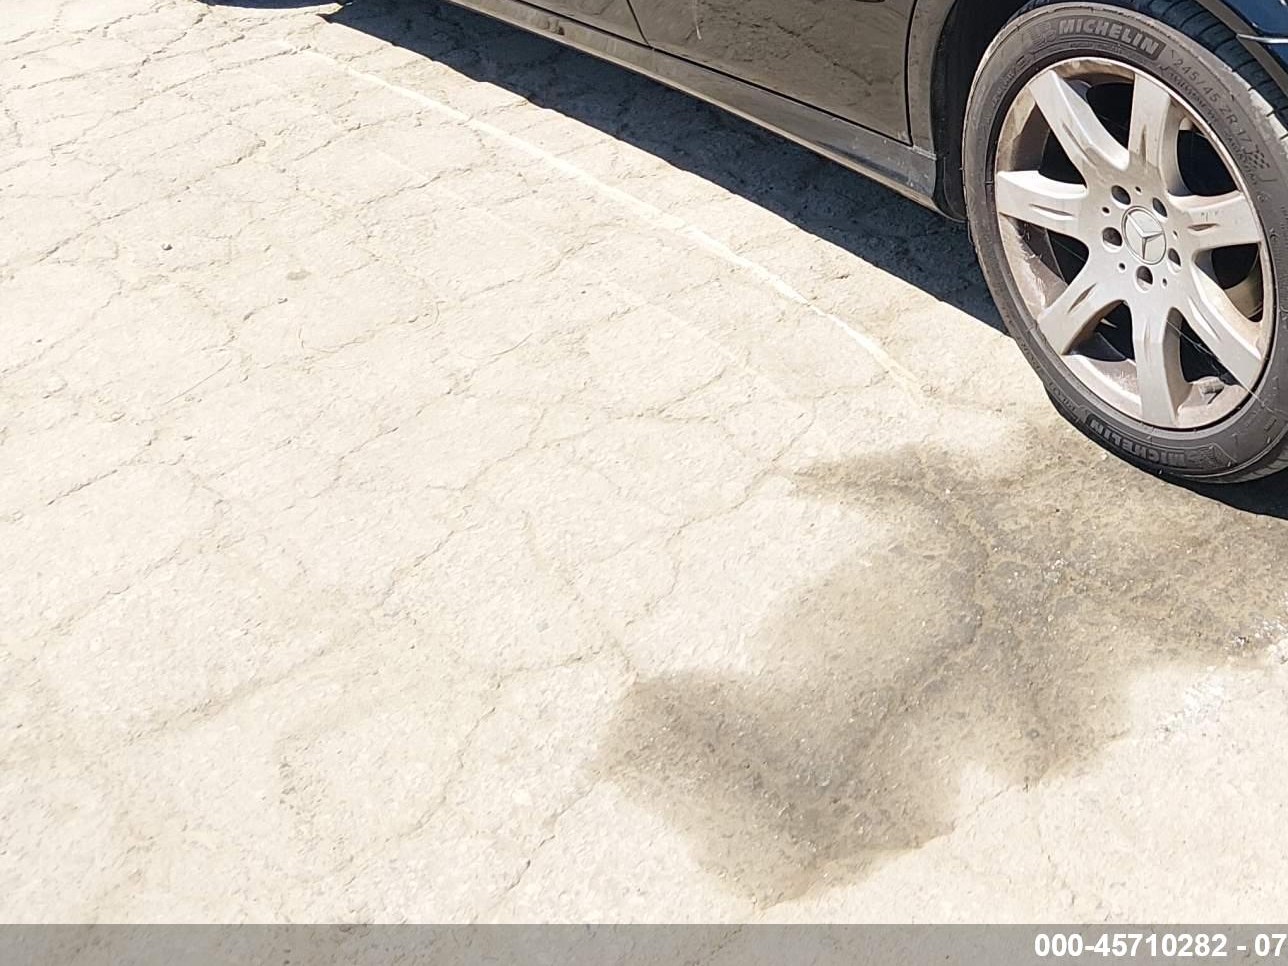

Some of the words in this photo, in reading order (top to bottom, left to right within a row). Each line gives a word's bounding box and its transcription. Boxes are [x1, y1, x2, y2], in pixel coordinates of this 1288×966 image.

[1060, 18, 1160, 55] MICHELIN
[1173, 58, 1221, 103] 245/45
[1219, 105, 1238, 125] ZR
[1090, 418, 1185, 467] MICHELIN
